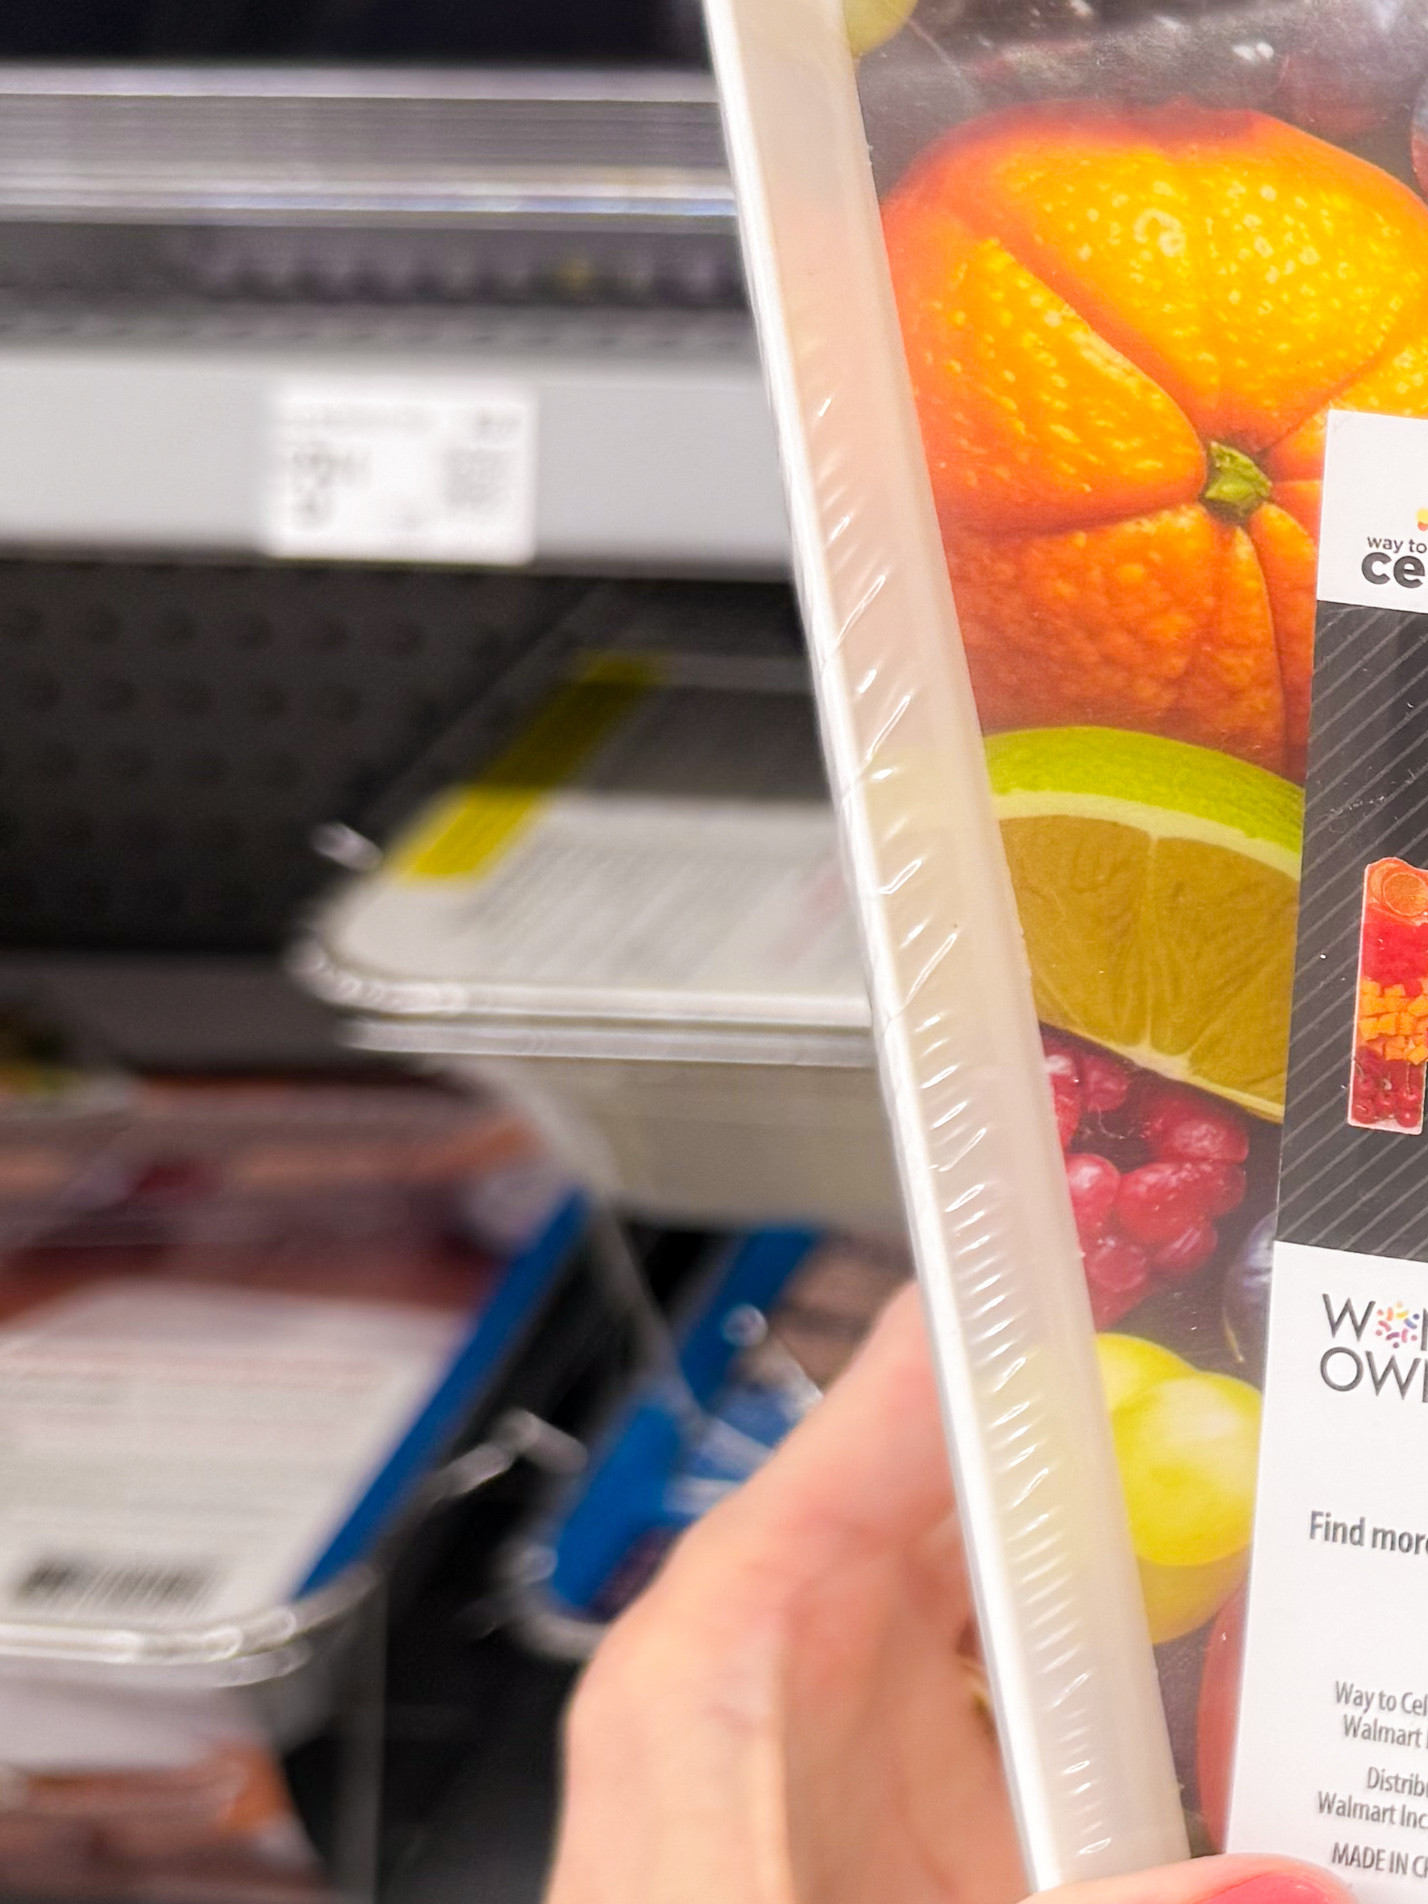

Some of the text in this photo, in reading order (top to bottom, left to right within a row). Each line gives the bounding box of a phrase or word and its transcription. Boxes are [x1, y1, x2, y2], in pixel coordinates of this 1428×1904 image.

[1367, 536, 1428, 554] way to
[1309, 1510, 1366, 1547] Find
[1335, 1681, 1375, 1714] Way
[1378, 1691, 1397, 1712] to
[1343, 1714, 1421, 1748] Walmart
[1318, 1791, 1396, 1825] Walmart
[1331, 1842, 1386, 1872] MADE
[1389, 1851, 1409, 1875] IN
